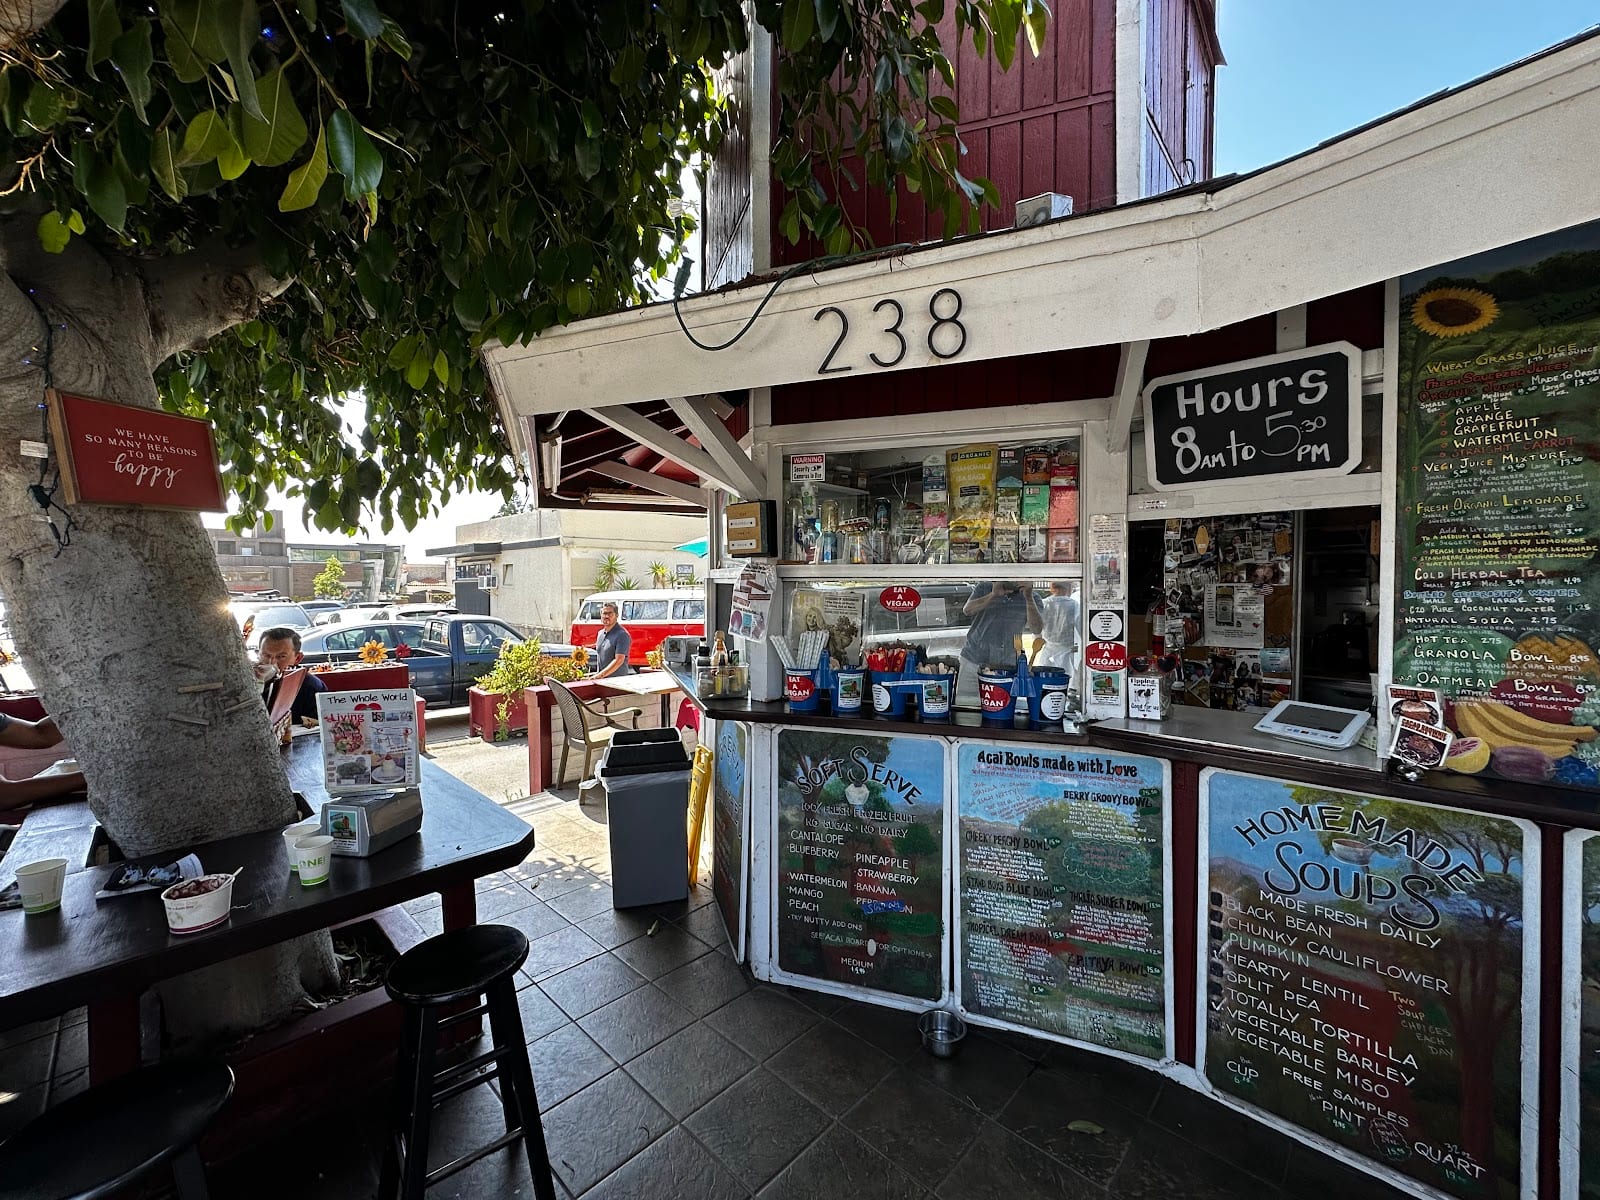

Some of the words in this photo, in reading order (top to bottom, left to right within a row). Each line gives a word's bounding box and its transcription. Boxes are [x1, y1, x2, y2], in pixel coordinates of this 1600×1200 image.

[814, 288, 966, 374] 238
[1427, 360, 1471, 374] WHEAT
[1476, 353, 1524, 366] GRASS
[1529, 343, 1577, 357] JUICE
[1526, 361, 1571, 375] JUICES
[1532, 374, 1558, 385] MADE
[1560, 370, 1573, 380] TO
[1176, 369, 1329, 419] Hours
[1455, 402, 1500, 416] APPLE
[1456, 410, 1513, 425] ORANGE
[115, 428, 133, 438] WE
[139, 432, 169, 443] HAVE
[1454, 417, 1540, 436] GRAPEFRUIT
[85, 434, 102, 443] SO
[108, 438, 141, 449] MANY
[147, 443, 197, 457] REASONS
[1454, 428, 1558, 449] WATERMELON
[128, 450, 143, 459] TO
[149, 452, 164, 462] BE
[1226, 430, 1256, 466] to
[1297, 443, 1330, 463] PM
[1424, 462, 1453, 472] VEGI
[1460, 457, 1493, 469] JUICE
[1502, 450, 1567, 464] MIXTURE
[109, 453, 183, 488] happy
[1416, 502, 1449, 515] FRESH
[1502, 494, 1583, 508] LEMONADE
[1414, 567, 1444, 580] COLD
[1452, 567, 1507, 579] HERBAL
[1517, 566, 1545, 577] TEA
[1528, 588, 1581, 597] WATER
[1469, 616, 1514, 624] SODA
[1416, 635, 1438, 644] HOT
[1090, 658, 1123, 666] VEGAN
[1414, 645, 1496, 660] GRANOLA
[1510, 648, 1553, 662] BOWL
[1417, 672, 1497, 688] OATMEAL
[1514, 679, 1562, 694] BOWL
[328, 696, 346, 704] The
[350, 694, 378, 703] Whole
[382, 693, 407, 701] World
[977, 750, 1003, 765] Acai
[1005, 751, 1040, 768] Bowls
[1041, 755, 1075, 771] made
[1077, 758, 1104, 773] with
[1106, 760, 1138, 777] Love
[797, 758, 845, 795] SOFT
[847, 746, 922, 805] SERVE
[1064, 790, 1090, 801] BERRY
[1122, 794, 1152, 807] BOWL
[853, 808, 888, 821] FROZEN
[889, 811, 916, 824] FRUIT
[790, 830, 845, 845] CANTALOPE
[805, 818, 819, 828] NO
[860, 824, 875, 834] NO
[878, 826, 908, 839] DAIRY
[790, 844, 839, 859] BLUEBERRY
[1023, 837, 1050, 851] BOWL
[1233, 805, 1485, 894] HOMEMADE
[856, 852, 909, 870] PINEAPPLE
[789, 872, 848, 889] WATERMELON
[857, 868, 919, 885] STRAWBERRY
[788, 886, 824, 899] MANGO
[856, 882, 896, 897] BANANA
[1006, 883, 1030, 896] BLUE
[1264, 841, 1441, 931] SOUPS
[788, 899, 819, 912] PEACH
[804, 915, 829, 926] NUTTY
[832, 920, 845, 928] ADD
[848, 923, 863, 931] ONS
[1225, 899, 1276, 923] BLACK
[1285, 916, 1332, 938] BEAN
[1260, 890, 1307, 914] MADE
[1315, 905, 1368, 928] FRESH
[1380, 921, 1441, 949] DAILY
[1227, 917, 1298, 946] CHUNKY
[1307, 941, 1451, 995] CAULIFLOWER
[1228, 933, 1309, 968] PUMPKIN
[841, 957, 874, 969] MEDIUM
[1225, 951, 1291, 981] HEARTY
[1301, 977, 1370, 1009] LENTIL
[1227, 971, 1273, 995] SPLIT
[1284, 990, 1321, 1012] PEA
[1388, 990, 1415, 1006] TWO
[1227, 987, 1299, 1023] TOTALLY
[1310, 1018, 1418, 1069] TORTILLA
[1227, 1007, 1325, 1053] VEGETABLE
[1336, 1049, 1416, 1087] BARLEY
[1416, 1033, 1444, 1045] EACH
[1225, 1023, 1327, 1074] VEGETABLE
[1336, 1068, 1390, 1098] MISO
[1226, 1060, 1259, 1079] CUP
[1282, 1067, 1323, 1091] FREE
[1332, 1089, 1409, 1128] SAMPLES
[1322, 1100, 1365, 1128] PINT
[1414, 1142, 1487, 1179] QUART
